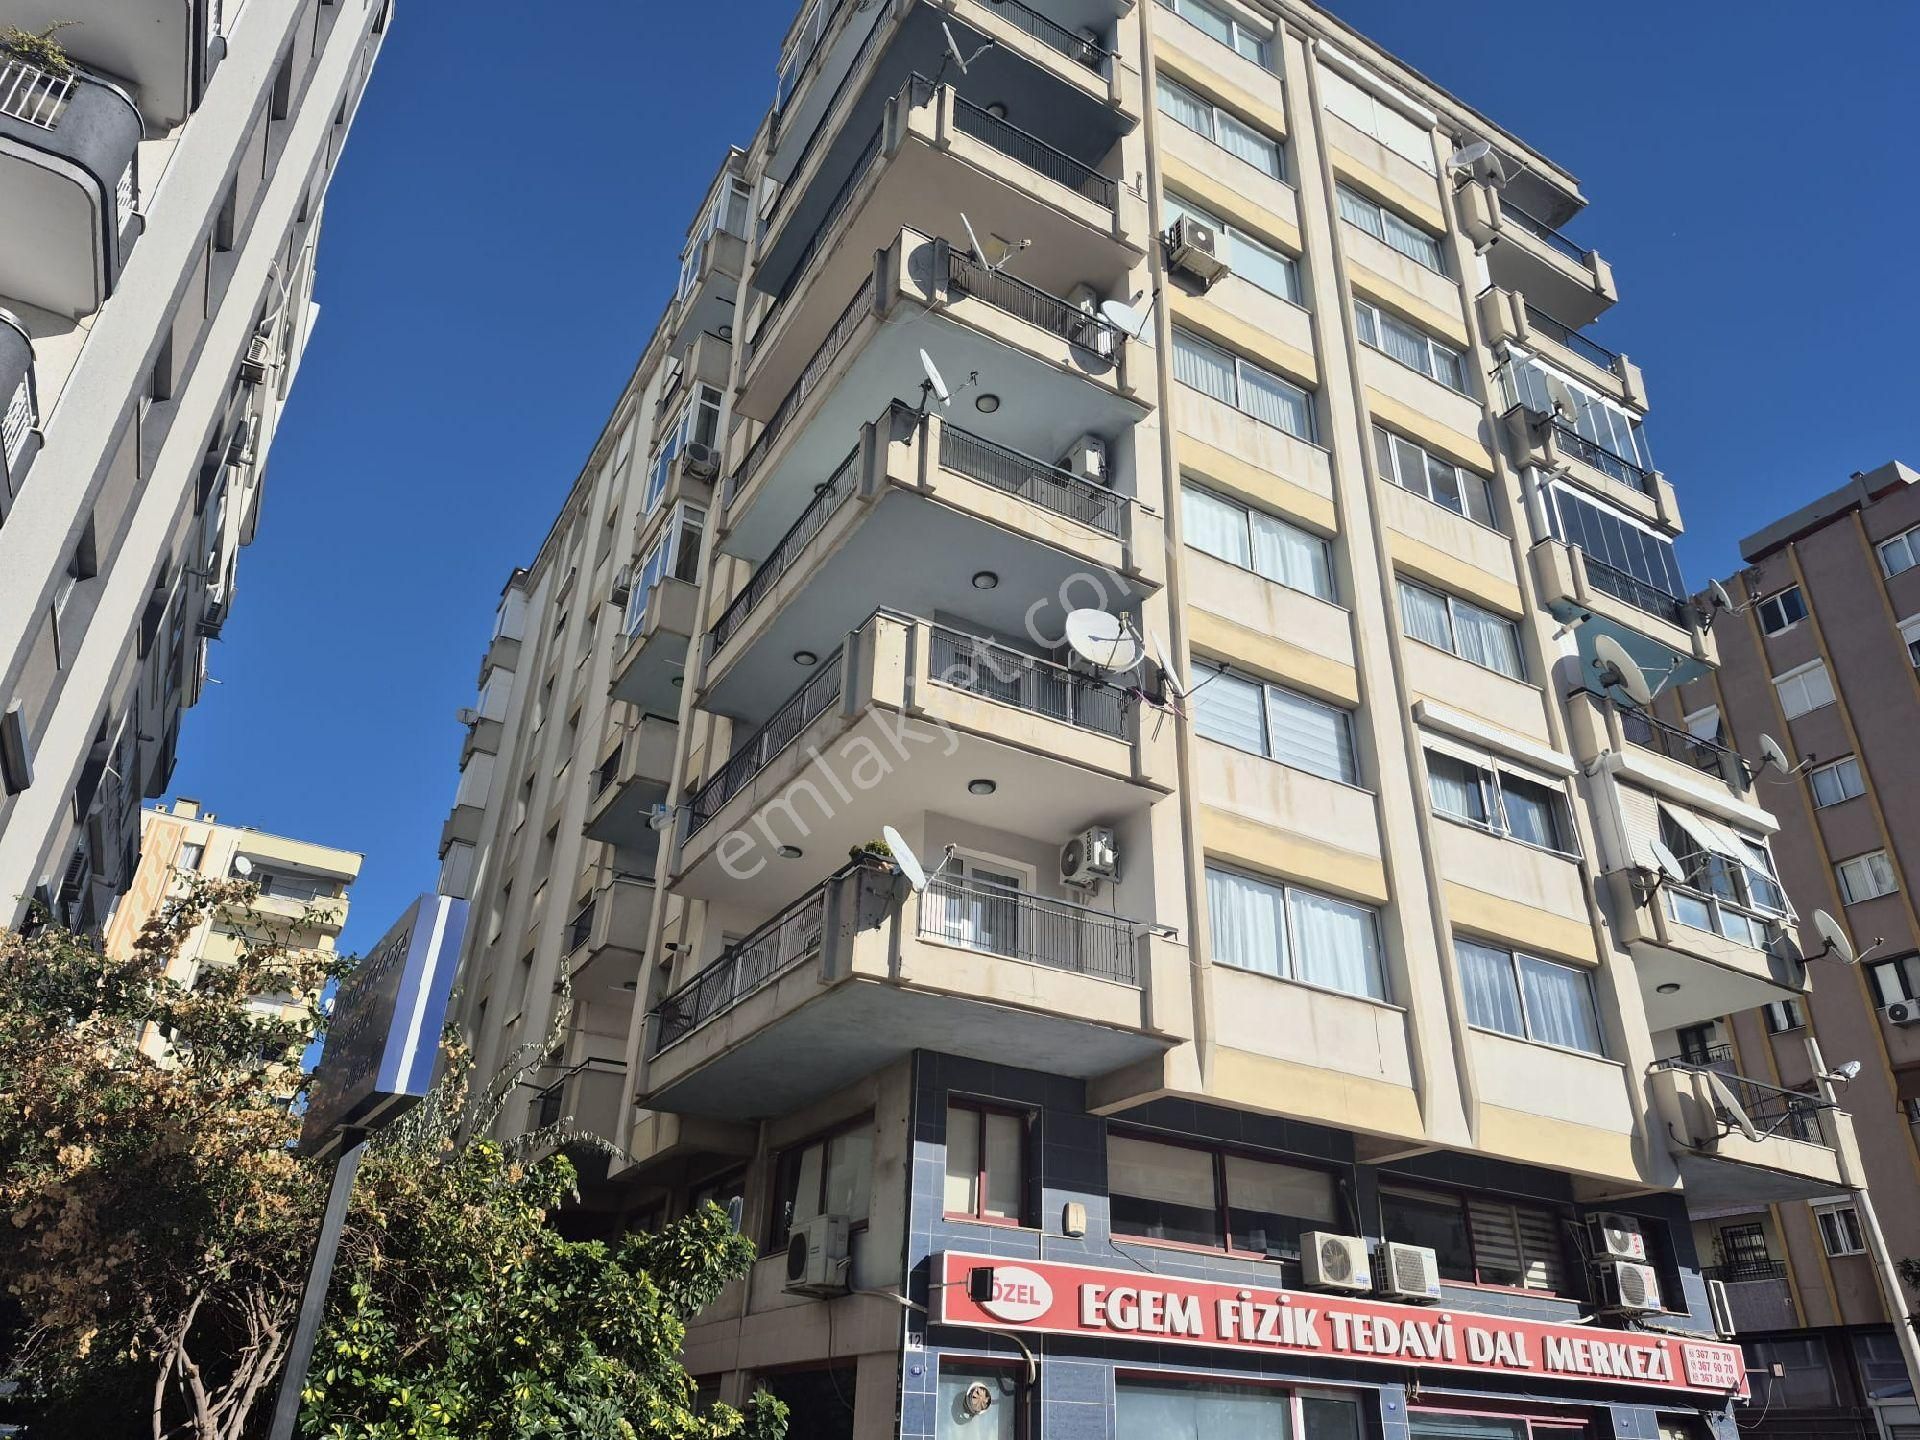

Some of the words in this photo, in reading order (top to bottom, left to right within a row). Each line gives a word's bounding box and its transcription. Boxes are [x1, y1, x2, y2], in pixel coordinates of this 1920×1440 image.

[1081, 1283, 1204, 1335] EGEM
[1217, 1290, 1322, 1348] FİZİK
[1327, 1311, 1457, 1360] TEDAVİ
[1466, 1327, 1534, 1368] DAL
[1544, 1335, 1674, 1382] MERKEZİ
[908, 1333, 921, 1348] 12
[1695, 1349, 1709, 1360] 367
[1712, 1351, 1720, 1360] 70
[1723, 1353, 1732, 1362] 70
[1698, 1361, 1710, 1371] 367
[1724, 1364, 1734, 1374] 70
[1700, 1373, 1713, 1383] 367
